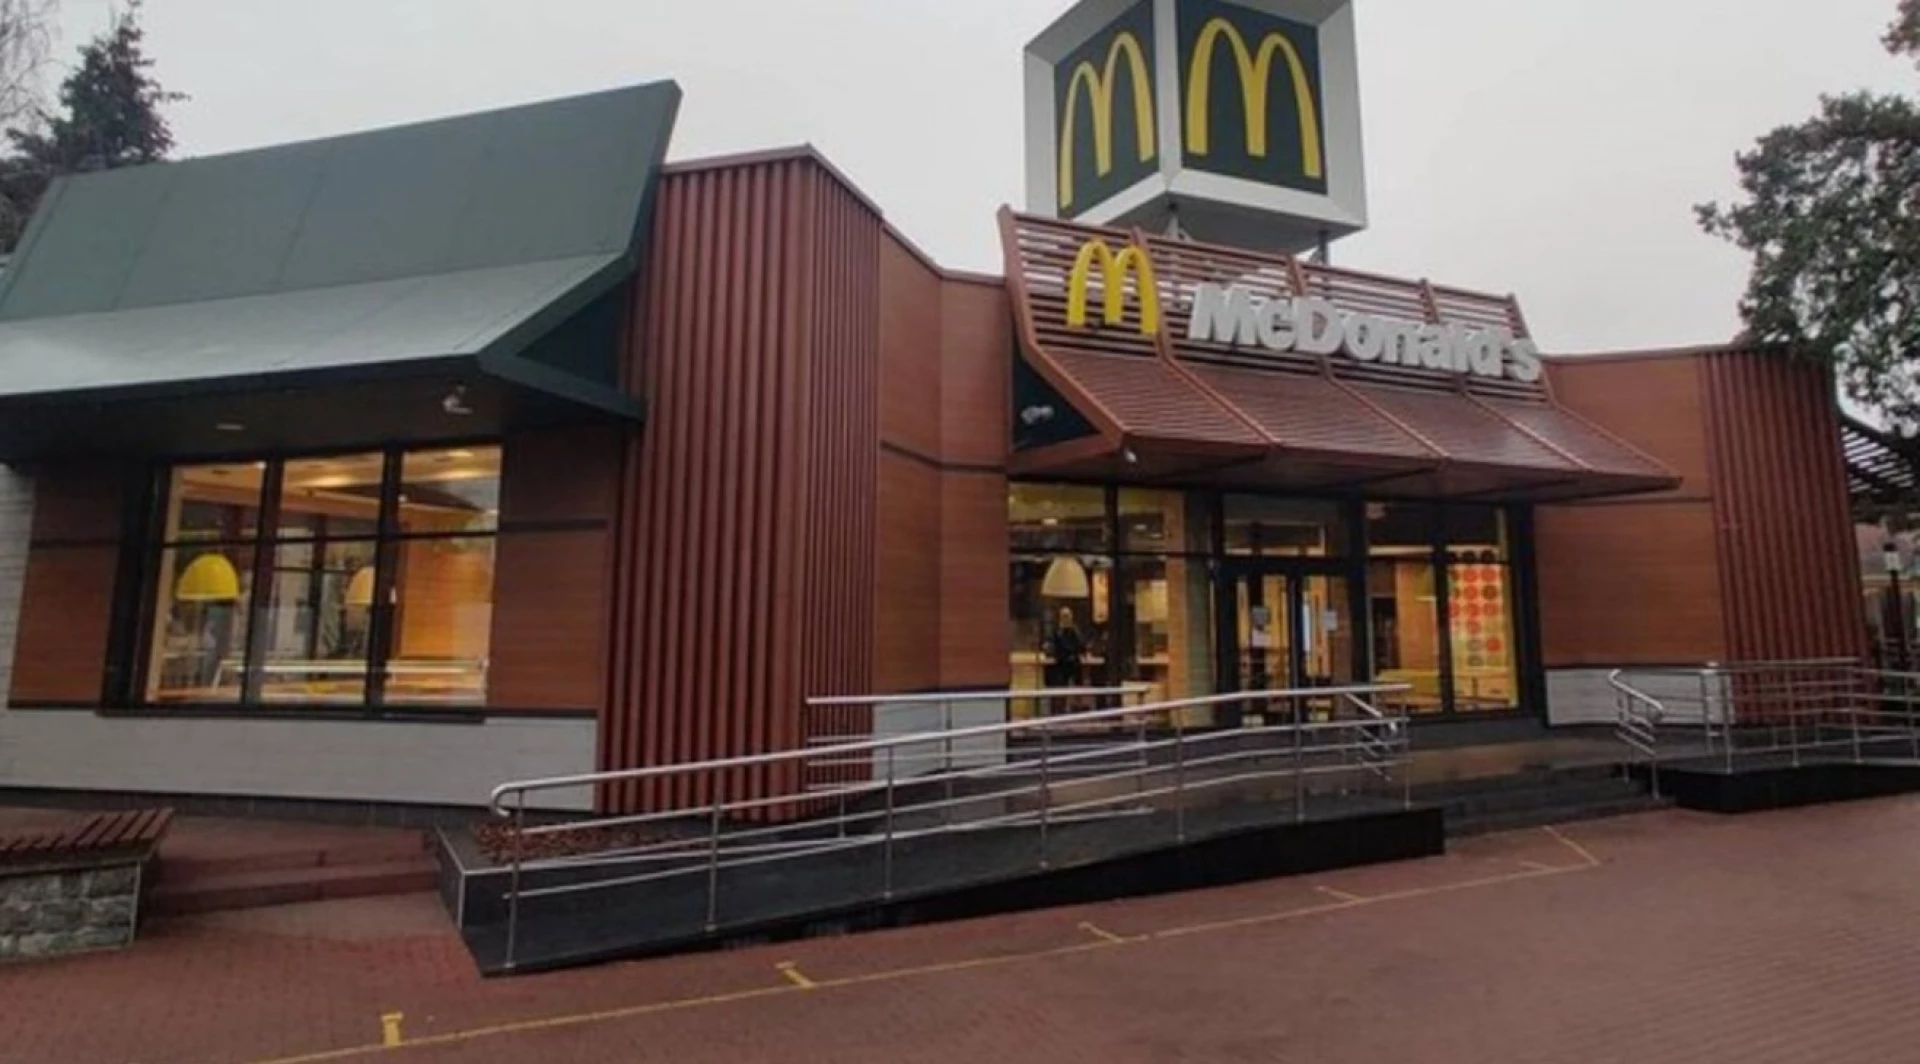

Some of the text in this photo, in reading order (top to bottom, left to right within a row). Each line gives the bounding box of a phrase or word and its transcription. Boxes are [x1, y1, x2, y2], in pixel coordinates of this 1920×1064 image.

[1186, 17, 1322, 180] M
[1066, 240, 1158, 334] M
[1187, 282, 1541, 382] McDonald's
